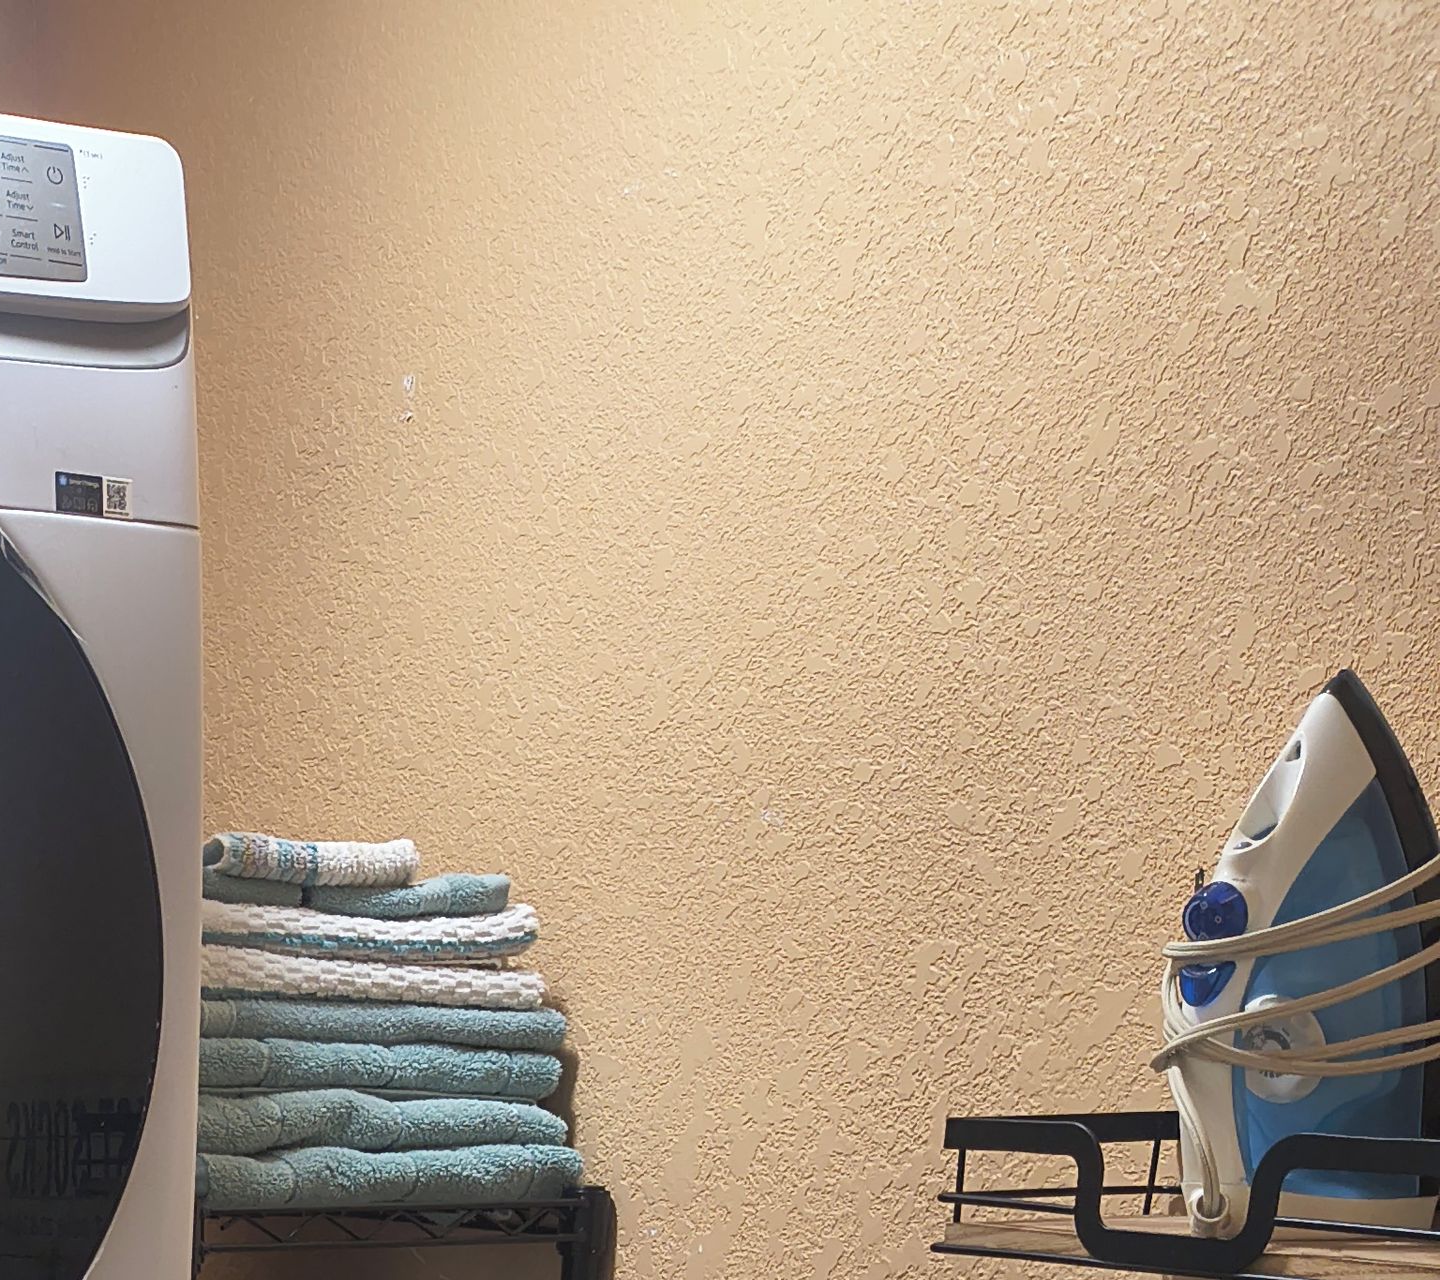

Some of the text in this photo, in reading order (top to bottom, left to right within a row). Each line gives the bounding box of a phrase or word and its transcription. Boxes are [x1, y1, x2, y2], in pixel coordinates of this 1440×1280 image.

[1, 152, 24, 163] Adjust
[2, 162, 20, 172] Time
[6, 190, 29, 201] Adjust
[7, 200, 26, 211] Time
[12, 228, 35, 240] Smart
[11, 239, 39, 252] Control
